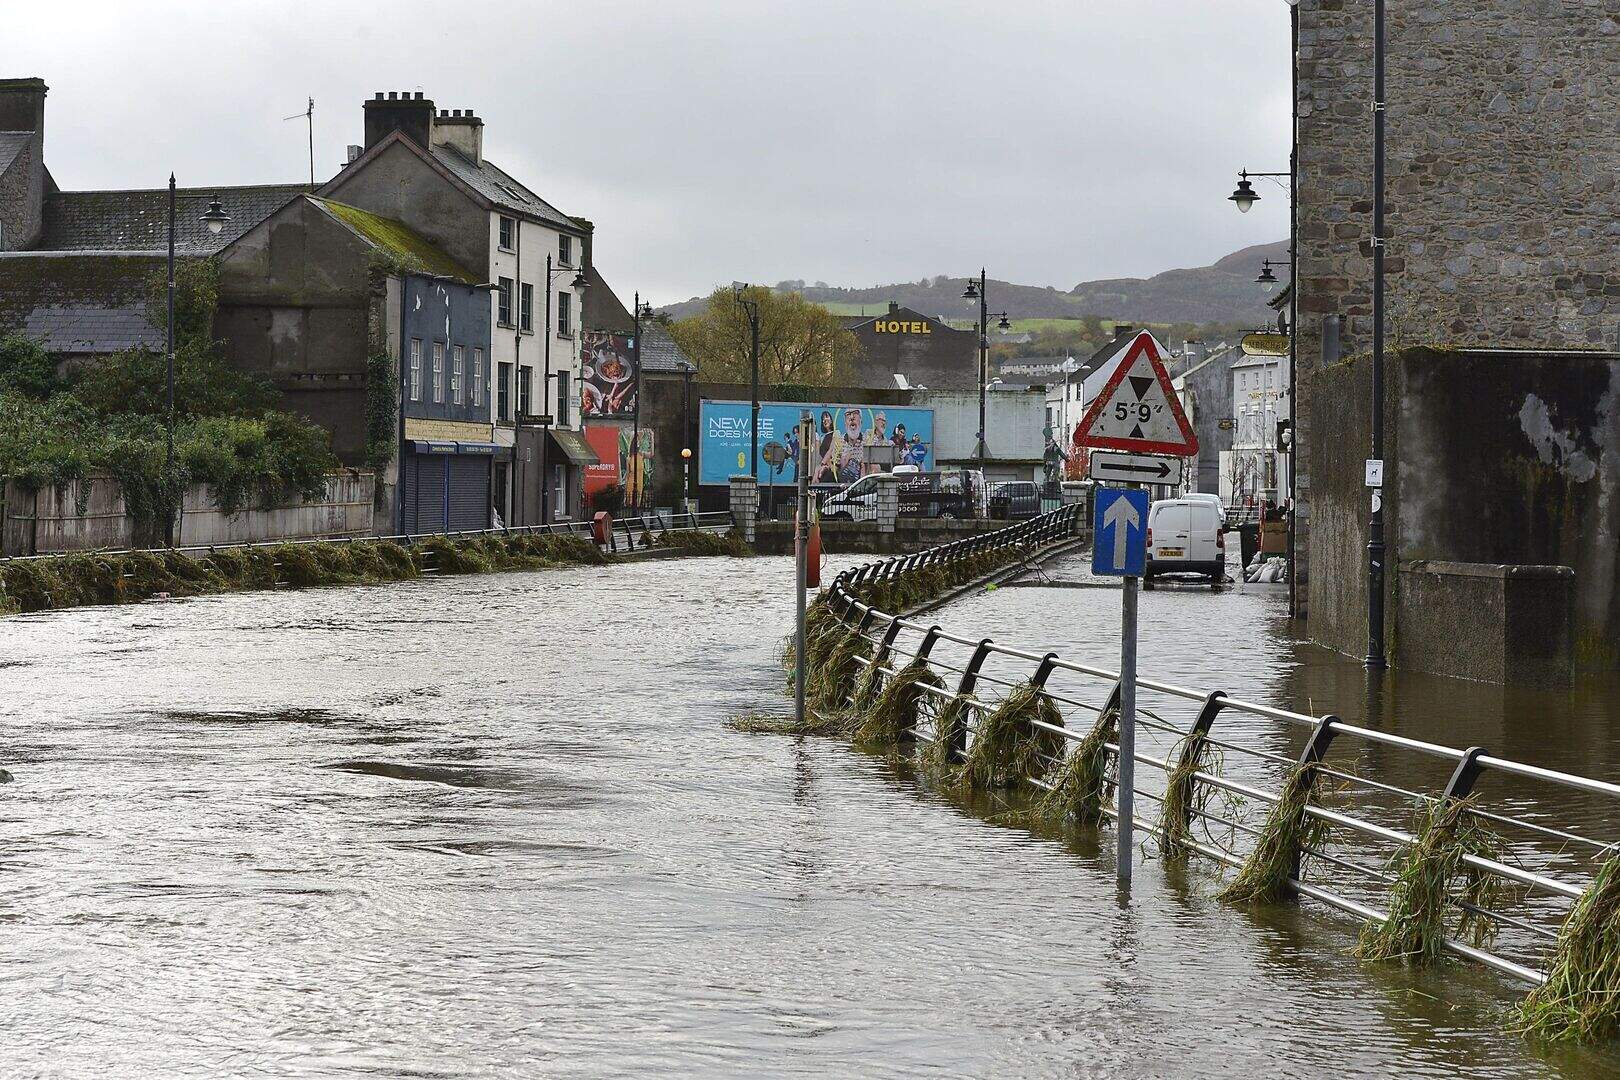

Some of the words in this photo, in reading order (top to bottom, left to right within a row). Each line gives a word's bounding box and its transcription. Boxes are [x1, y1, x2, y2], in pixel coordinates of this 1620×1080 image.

[875, 320, 931, 334] HOTEL
[709, 417, 749, 429] NEW
[709, 430, 740, 438] DOES
